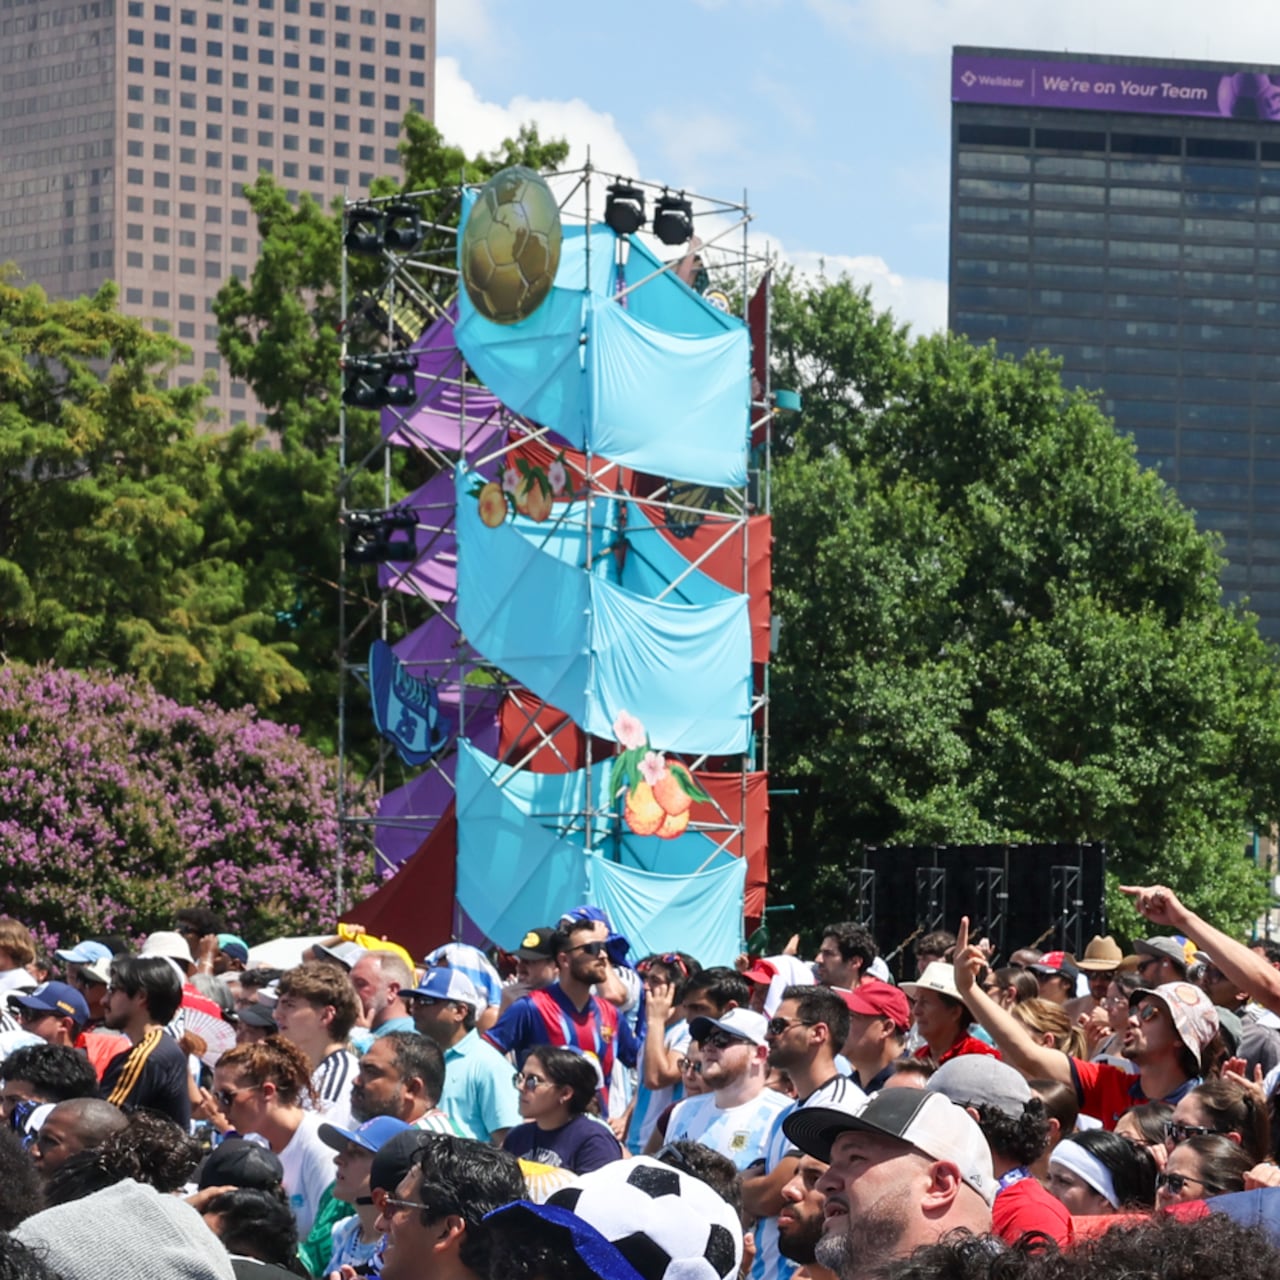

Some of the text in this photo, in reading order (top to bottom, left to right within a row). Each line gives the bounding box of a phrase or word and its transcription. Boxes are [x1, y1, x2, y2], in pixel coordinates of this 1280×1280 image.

[978, 75, 1024, 88] Wellstar
[1043, 76, 1208, 100] We're on Your Team
